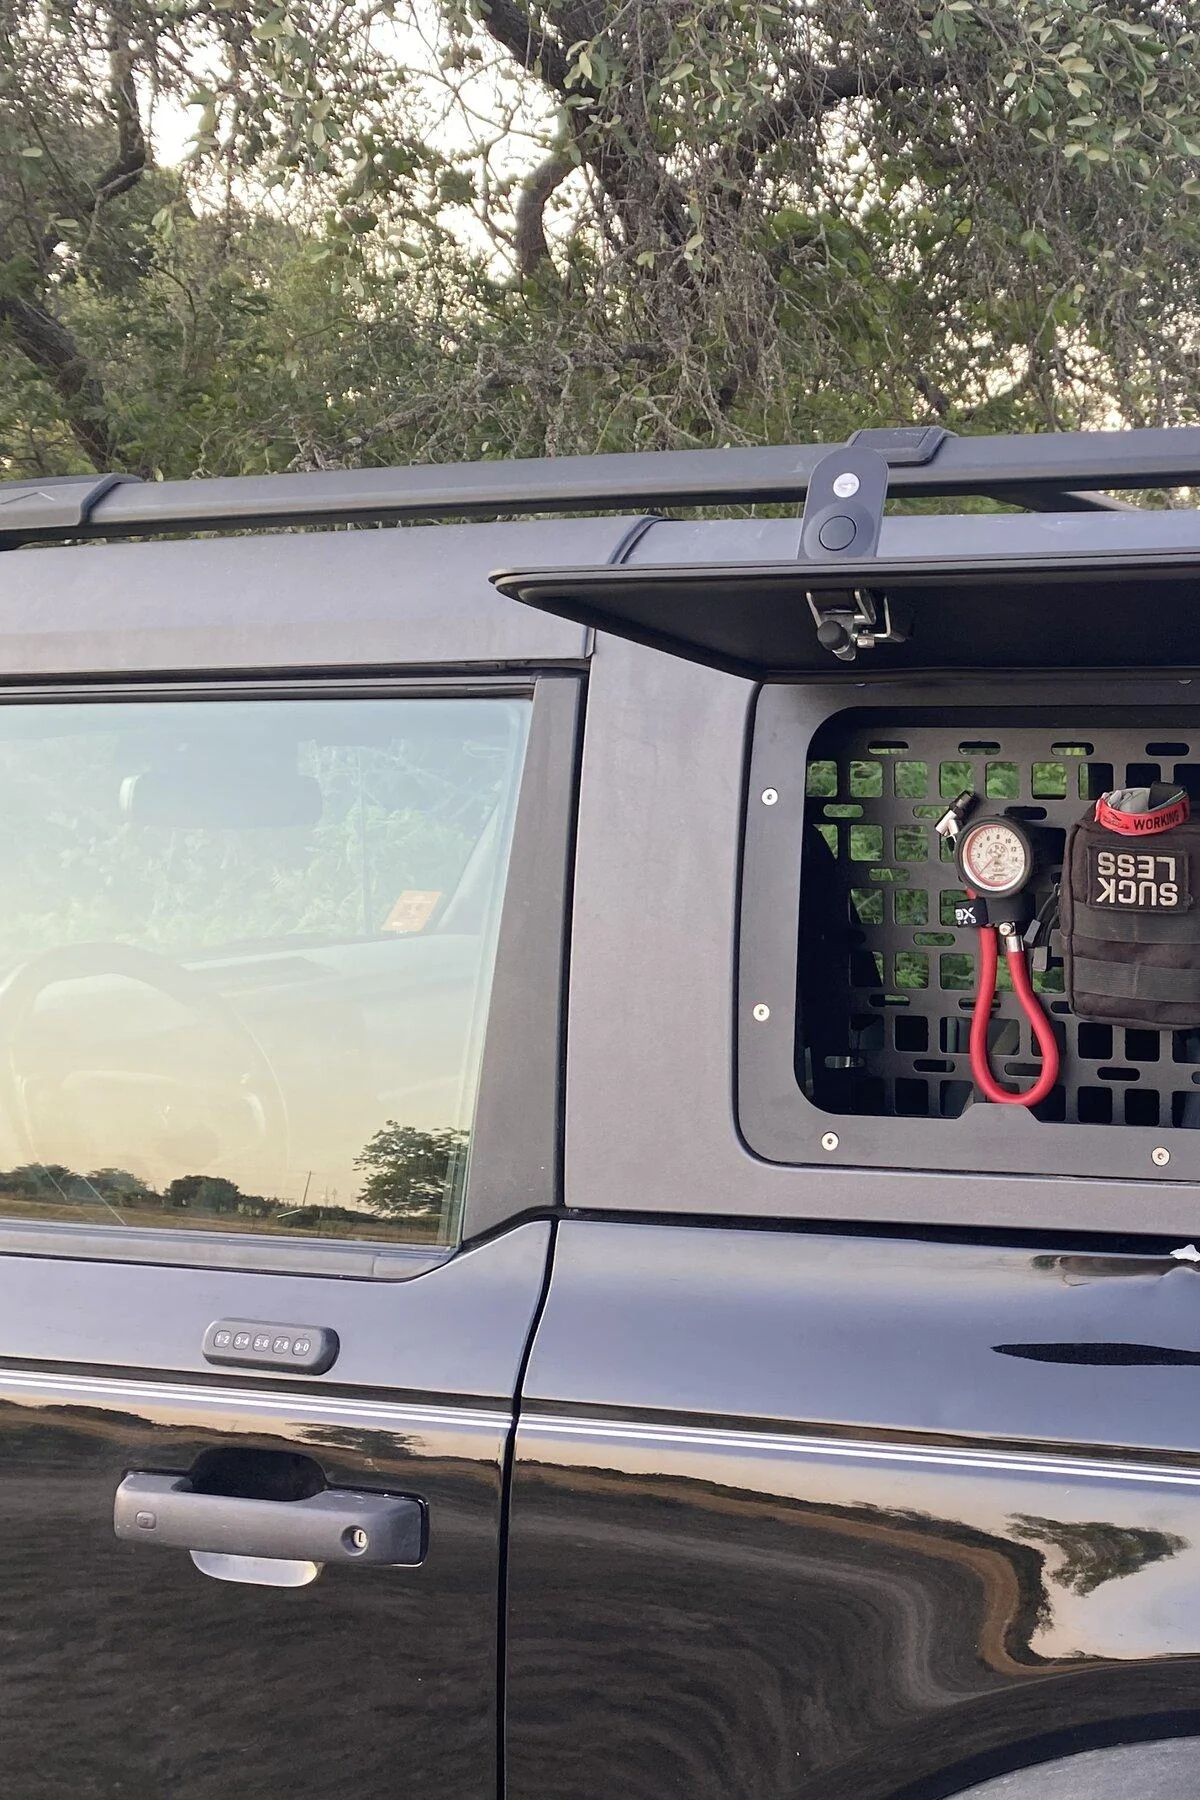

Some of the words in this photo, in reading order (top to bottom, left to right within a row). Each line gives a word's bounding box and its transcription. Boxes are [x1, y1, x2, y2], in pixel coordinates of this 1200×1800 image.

[1133, 811, 1179, 831] WORKING
[1097, 851, 1176, 881] LESS
[1096, 877, 1178, 906] SUCK
